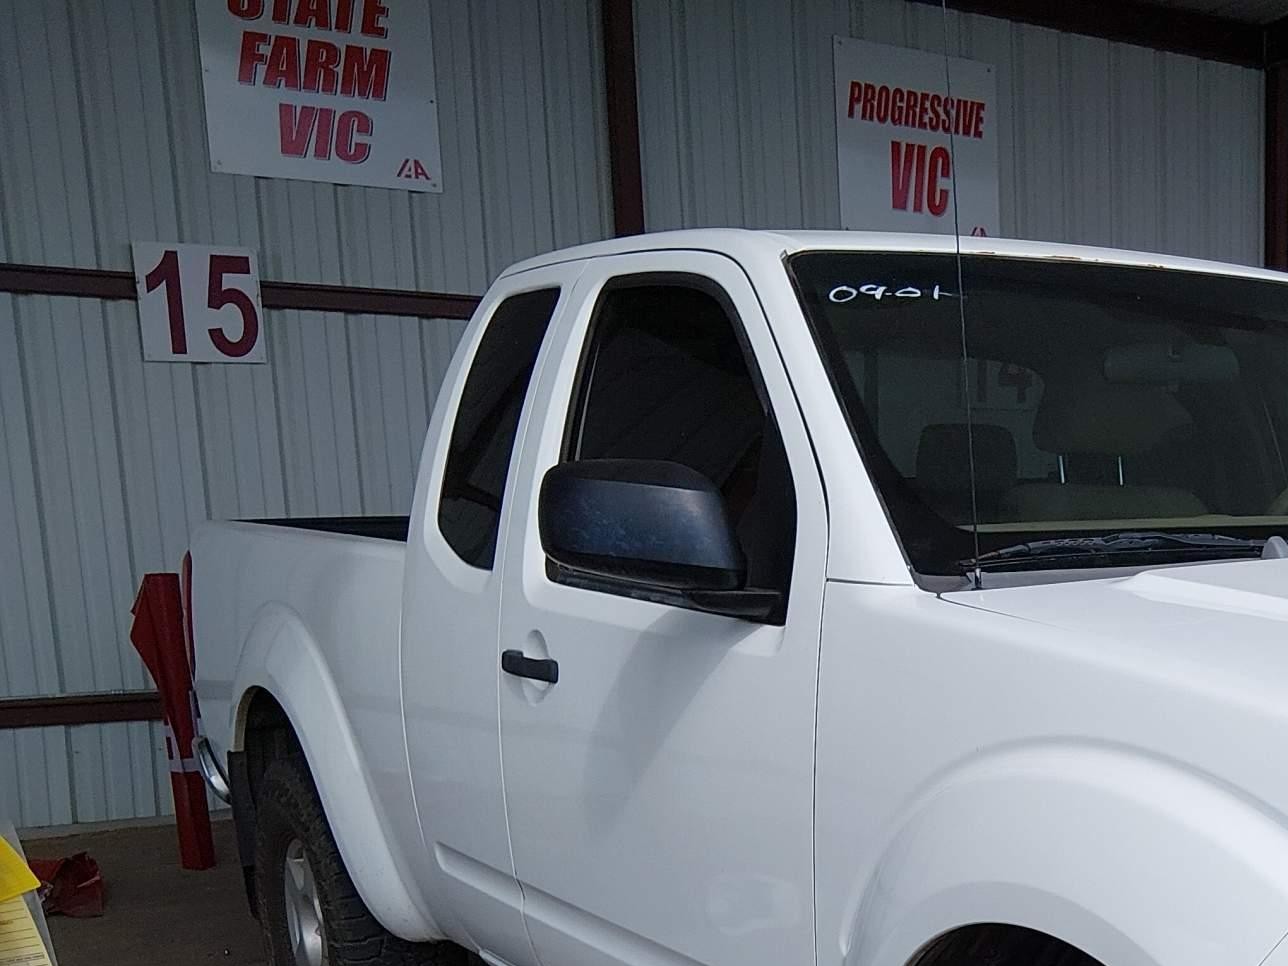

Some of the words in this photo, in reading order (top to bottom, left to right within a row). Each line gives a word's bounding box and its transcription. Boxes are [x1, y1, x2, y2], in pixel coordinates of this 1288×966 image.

[238, 31, 392, 102] FARM
[278, 102, 373, 165] VIC
[848, 80, 986, 140] PROGRESSIVE
[890, 140, 951, 217] VIC
[145, 250, 259, 358] 15
